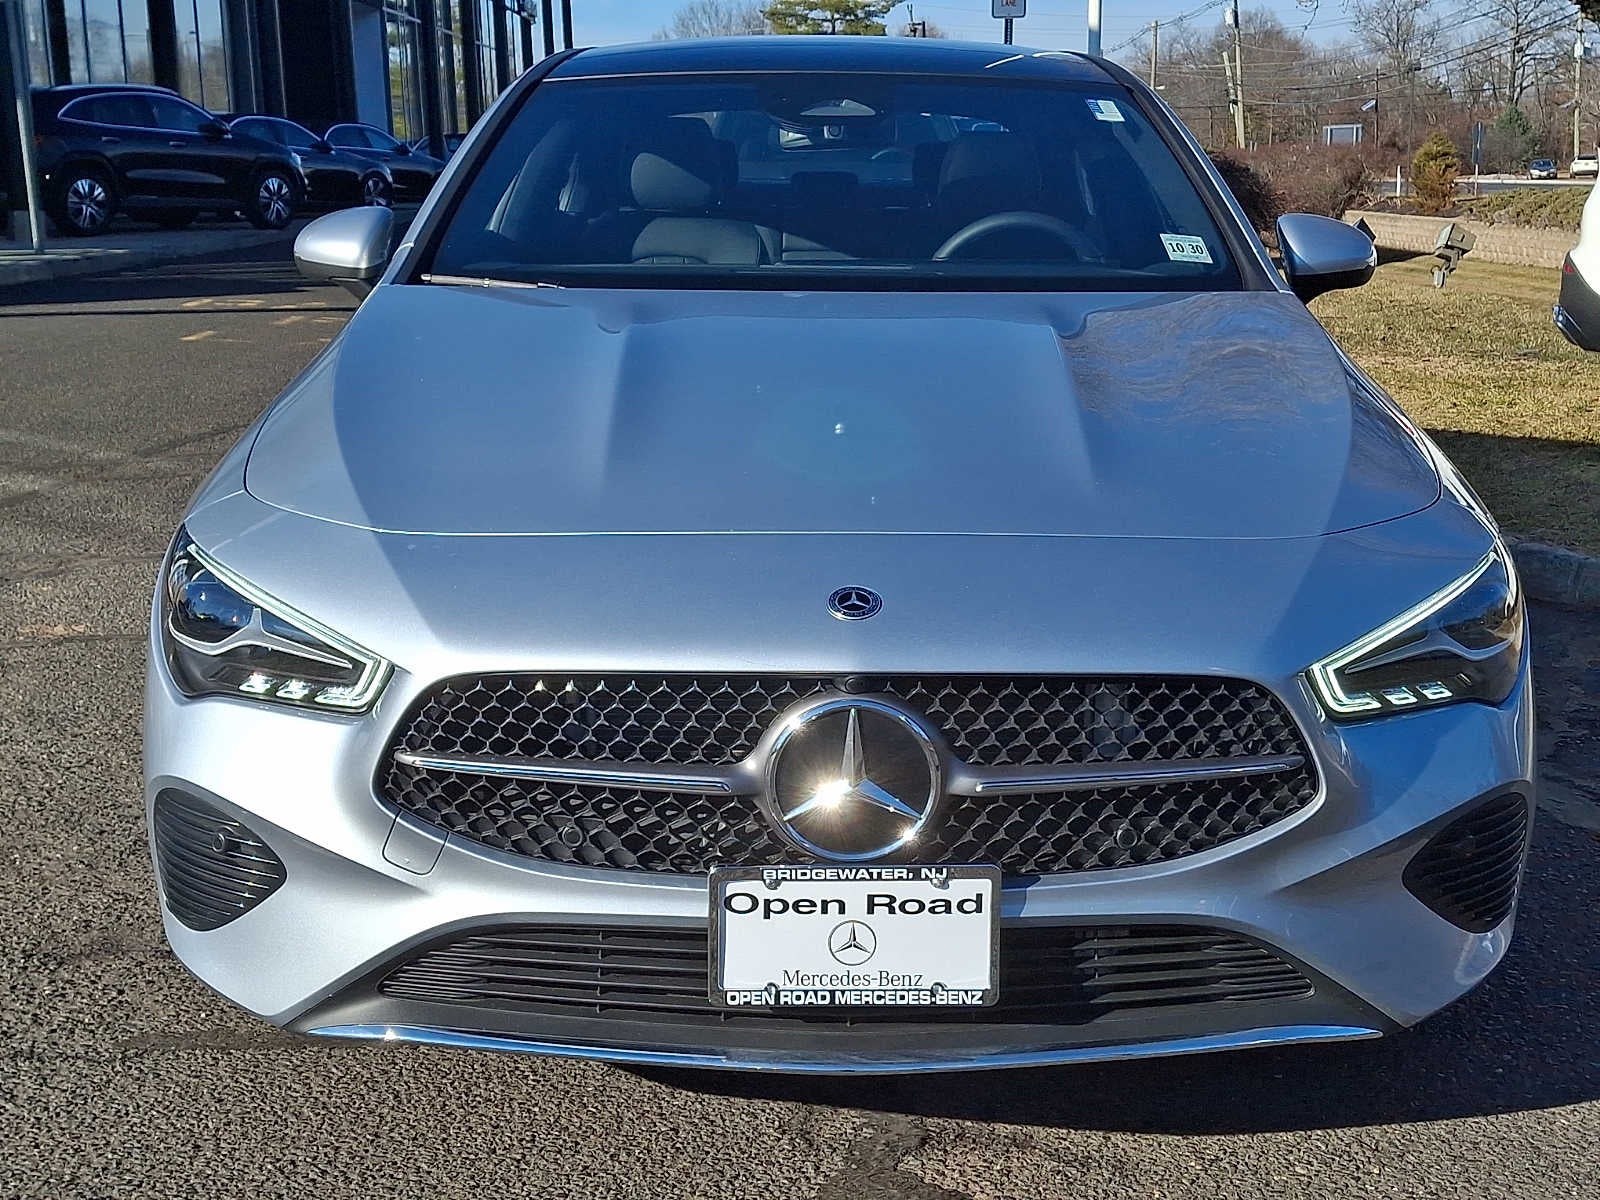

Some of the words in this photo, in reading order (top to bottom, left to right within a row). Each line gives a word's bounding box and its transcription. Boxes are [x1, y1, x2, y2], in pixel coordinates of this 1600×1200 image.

[1168, 242, 1185, 253] 10
[1188, 243, 1204, 255] 30
[763, 868, 913, 880] BRIDGEWATER,
[921, 867, 948, 880] NJ
[723, 892, 846, 920] Open
[866, 893, 984, 915] Road
[782, 969, 923, 987] Mercedes-Benz
[726, 990, 777, 1006] OPEN
[779, 990, 831, 1006] ROAD
[834, 990, 983, 1005] MERCEDES-BENZ
